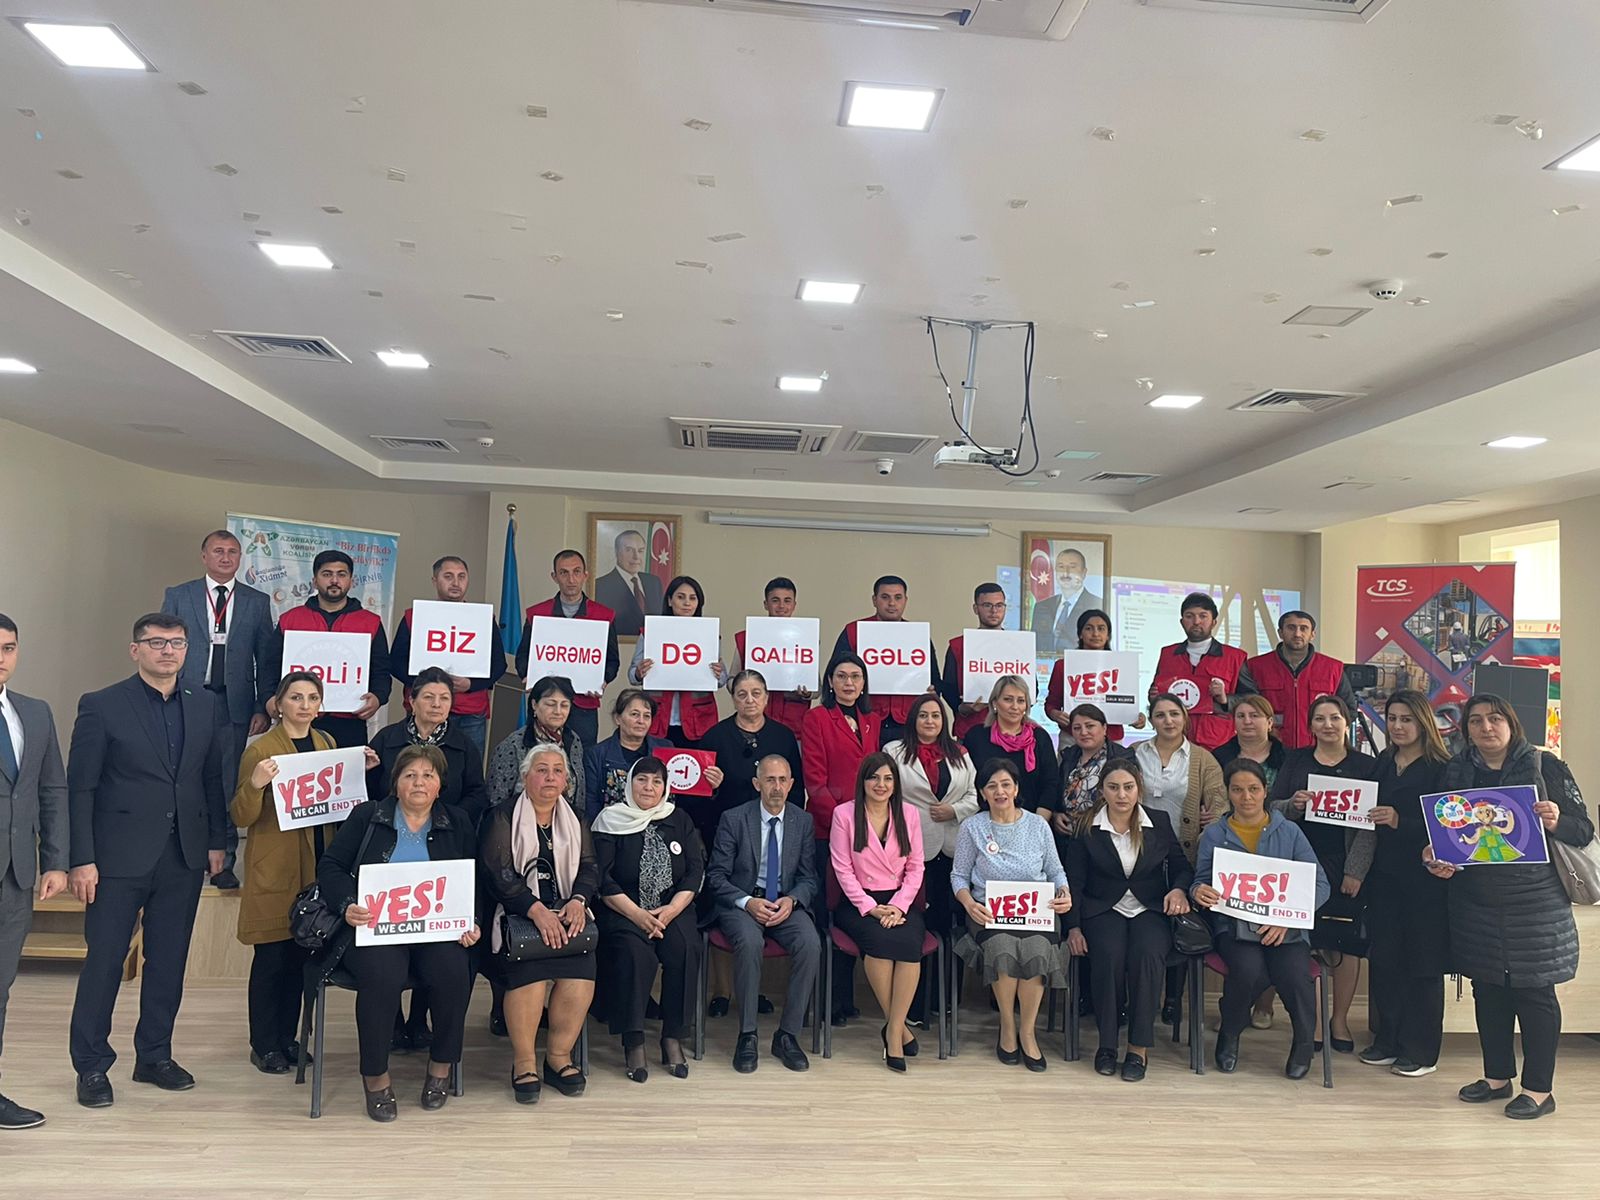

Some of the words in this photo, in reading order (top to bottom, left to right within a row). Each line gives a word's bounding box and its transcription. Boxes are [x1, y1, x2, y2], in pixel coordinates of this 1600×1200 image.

[1376, 579, 1408, 592] TCS
[426, 626, 476, 654] BİZ
[535, 644, 602, 665] VƏRƏMƏ
[662, 643, 702, 666] DƏ
[751, 644, 814, 664] QALİB
[863, 648, 926, 666] GƏLƏ
[969, 657, 1031, 675] BİLƏRİK
[1067, 668, 1119, 697] YES!
[277, 762, 344, 813] YES!
[292, 807, 307, 818] WE
[308, 804, 326, 816] CAN
[331, 800, 350, 811] END
[1311, 788, 1362, 812] YES!
[1218, 872, 1290, 904] YES!
[365, 876, 447, 929] YES!
[988, 890, 1039, 920] YES!
[1229, 899, 1245, 909] WE
[1246, 904, 1266, 915] CAN
[1272, 908, 1293, 918] END
[1294, 910, 1307, 919] TB
[378, 924, 396, 934] WE
[398, 922, 421, 933] CAN
[429, 920, 451, 930] END
[452, 919, 466, 928] TB
